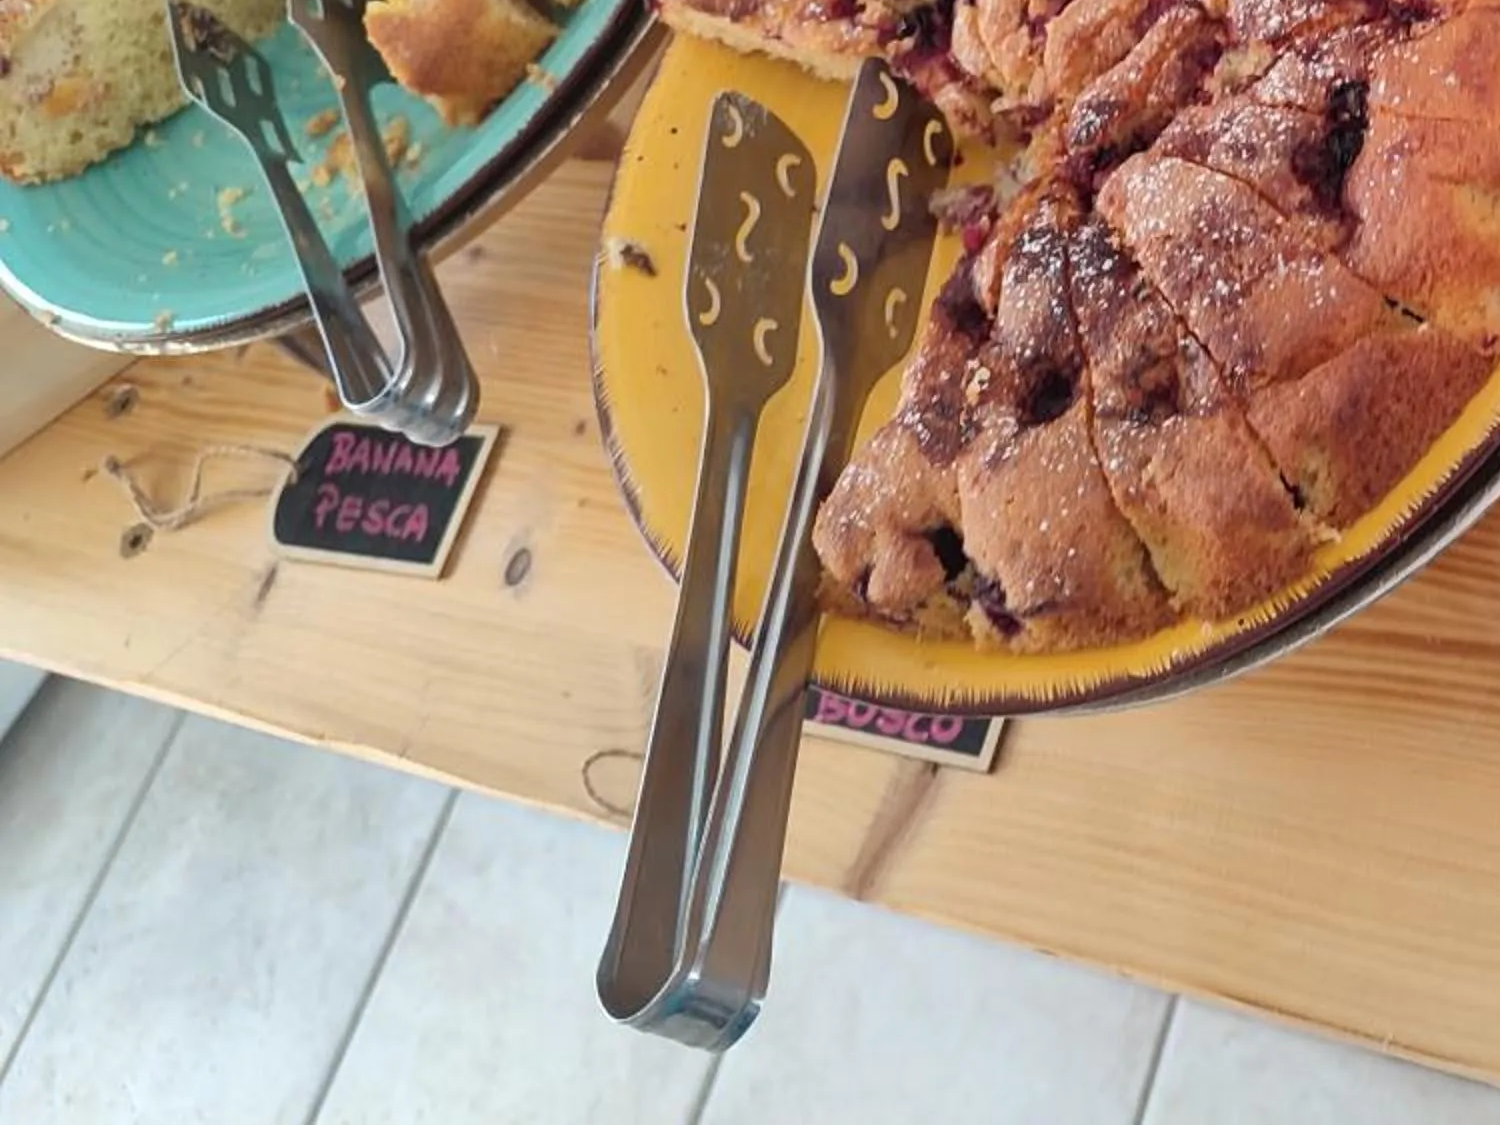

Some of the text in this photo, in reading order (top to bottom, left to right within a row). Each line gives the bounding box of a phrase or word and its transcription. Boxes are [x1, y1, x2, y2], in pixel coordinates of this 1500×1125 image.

[324, 431, 461, 487] BANANA
[313, 481, 430, 542] PESCA
[813, 689, 965, 744] BOSCO
